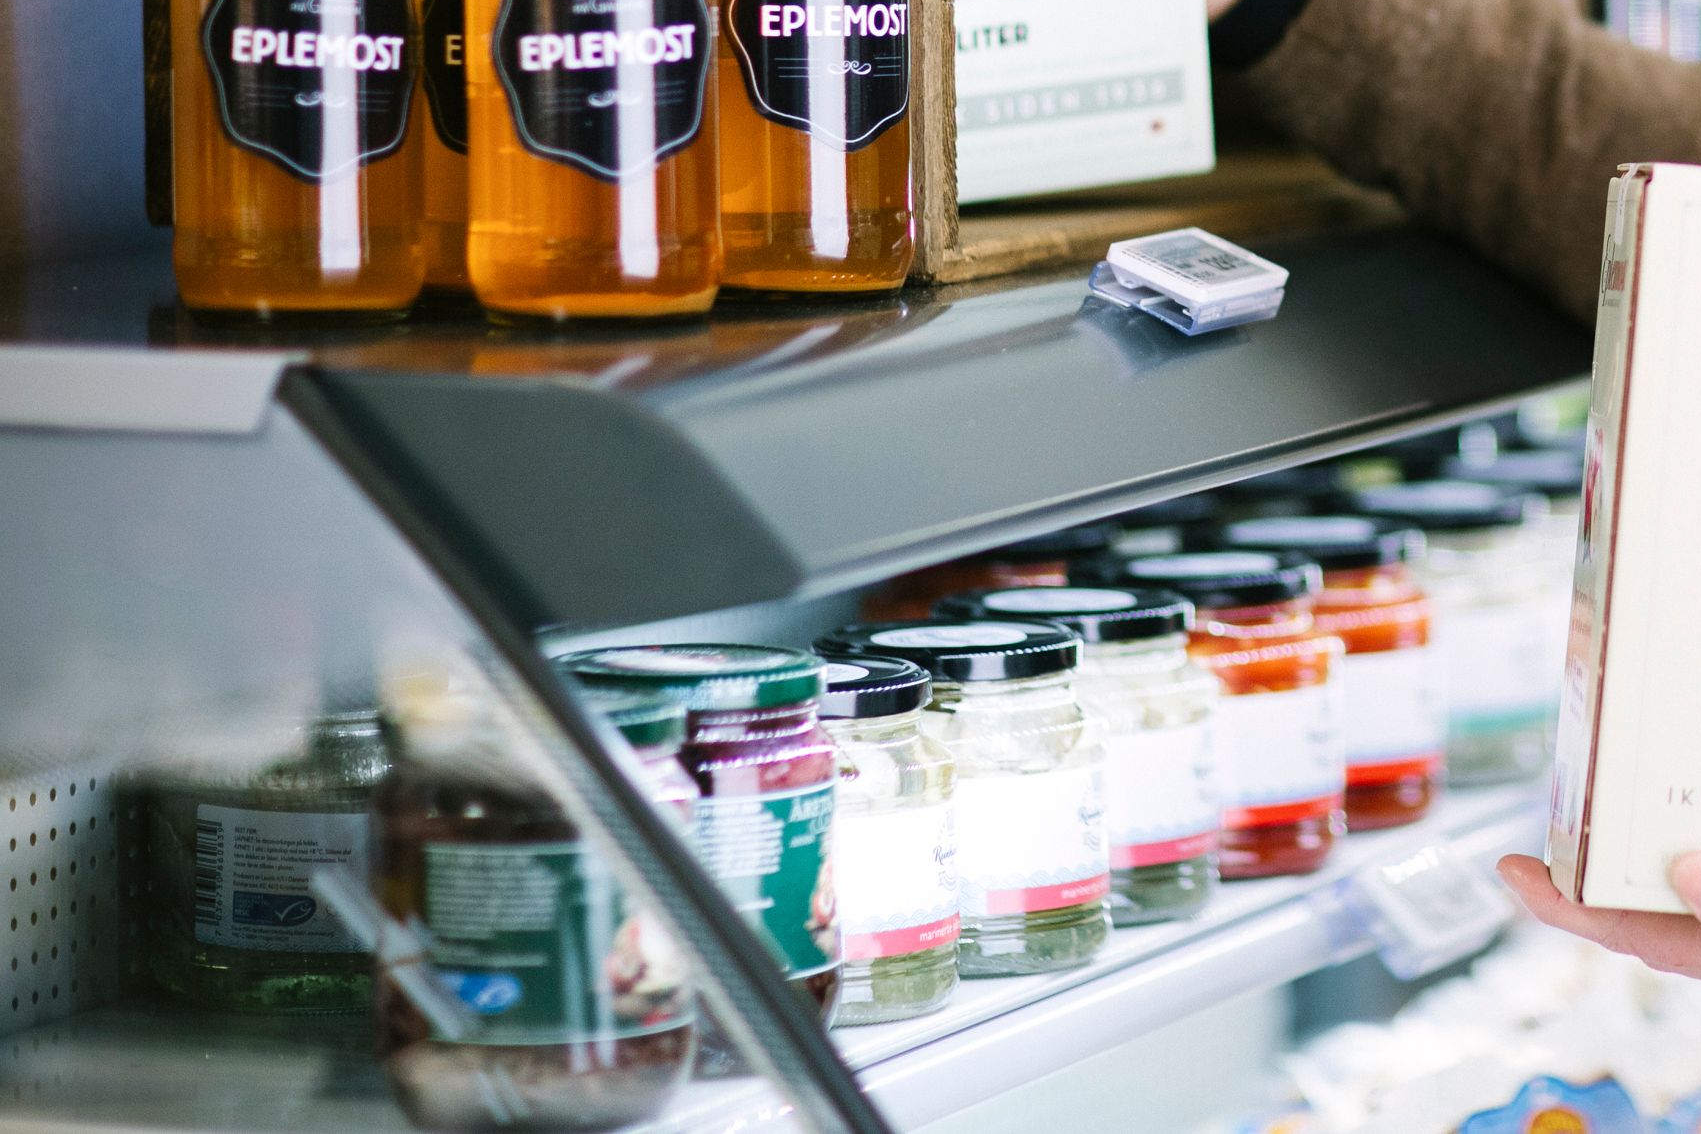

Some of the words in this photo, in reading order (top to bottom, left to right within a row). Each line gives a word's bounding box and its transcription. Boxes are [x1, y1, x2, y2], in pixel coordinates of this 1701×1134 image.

[761, 3, 907, 37] EPLEMOST
[231, 26, 405, 72] EPLEMOST
[518, 24, 696, 72] EPLEMOST
